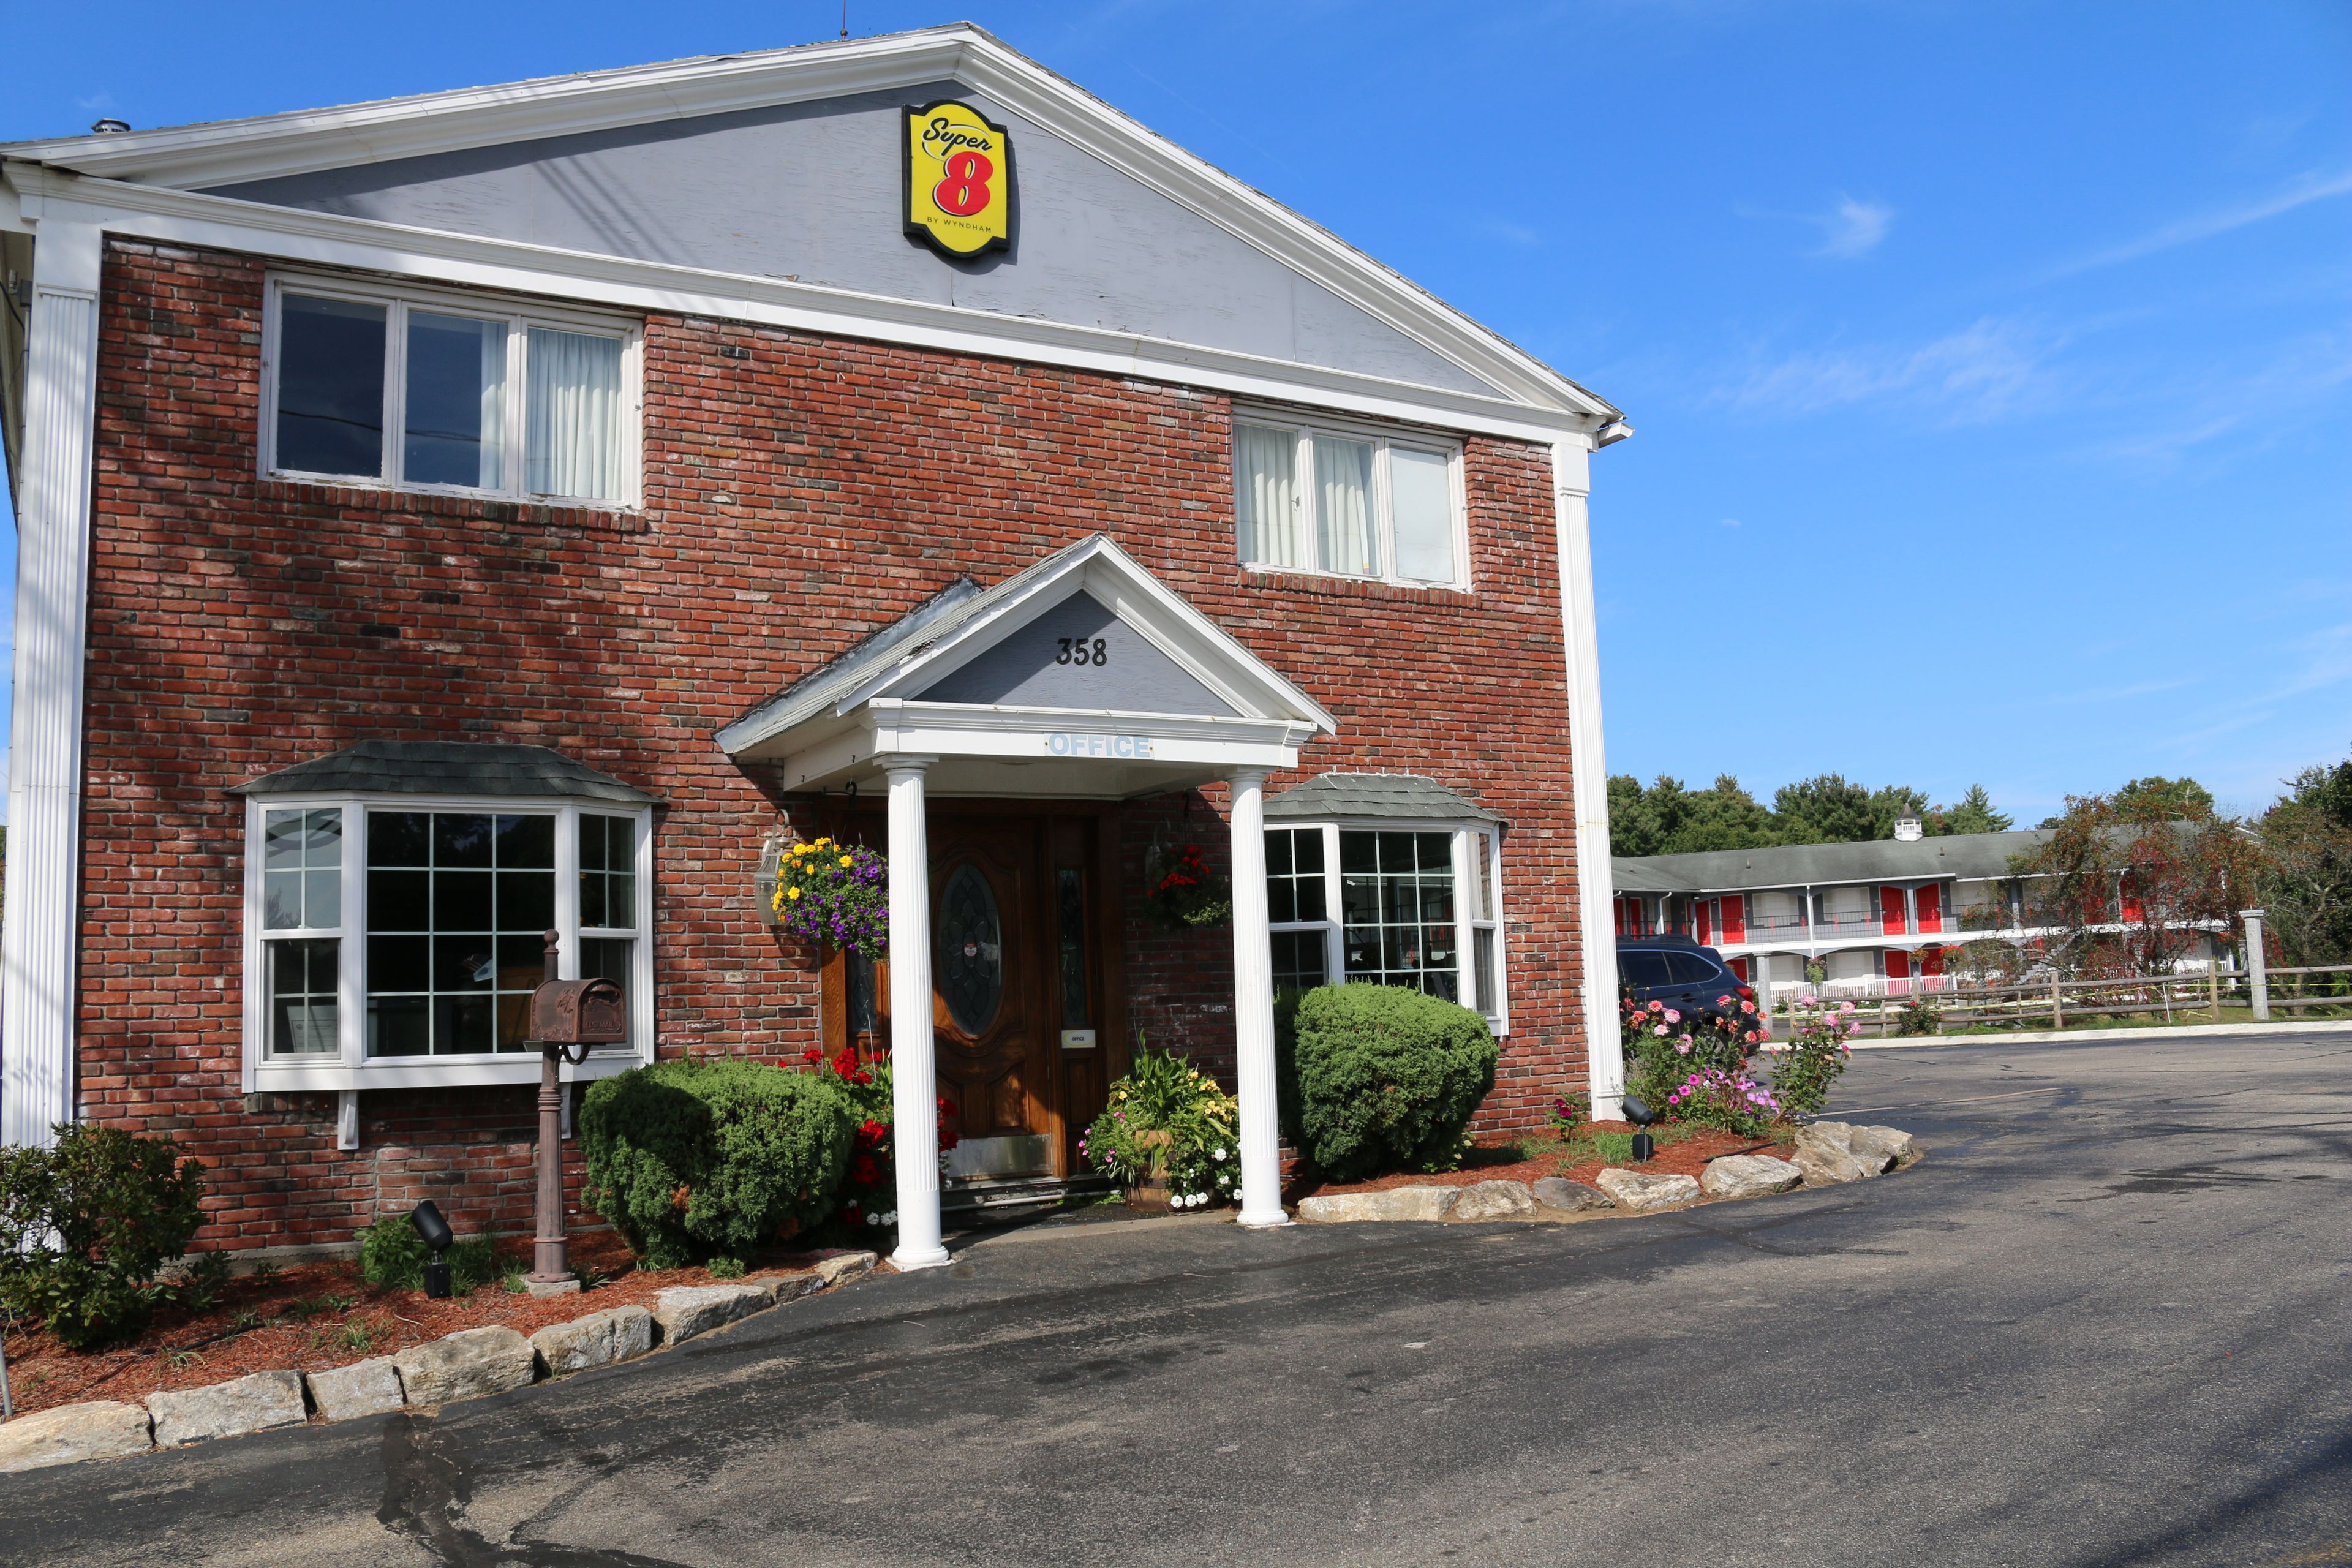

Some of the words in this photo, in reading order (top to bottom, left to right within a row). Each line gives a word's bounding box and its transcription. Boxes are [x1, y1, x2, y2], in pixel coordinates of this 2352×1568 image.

[922, 118, 992, 156] Super
[932, 151, 993, 217] 8
[943, 219, 992, 233] WYNDHAM
[1056, 638, 1107, 666] 358
[1049, 733, 1150, 758] OFFICE
